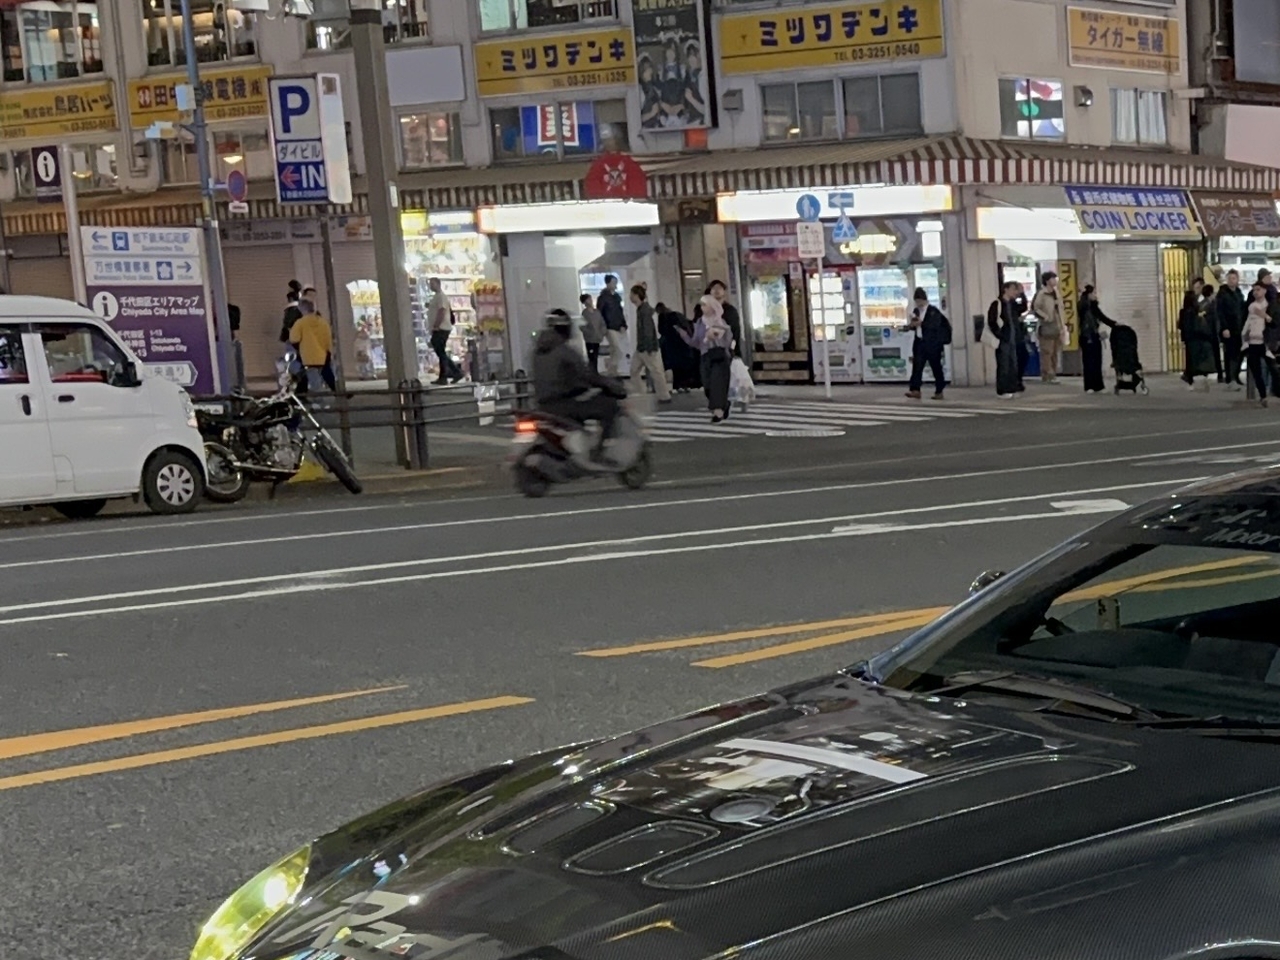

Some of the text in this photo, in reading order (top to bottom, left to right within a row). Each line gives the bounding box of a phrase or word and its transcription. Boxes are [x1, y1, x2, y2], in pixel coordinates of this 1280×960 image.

[1087, 24, 1164, 53] タイガー無線
[278, 85, 310, 134] P
[280, 143, 321, 160] ダイビル
[301, 165, 326, 188] IN
[1081, 209, 1191, 231] COIN LOCKER
[121, 307, 152, 318] Chiyoda
[154, 307, 169, 318] City
[170, 307, 188, 316] Area
